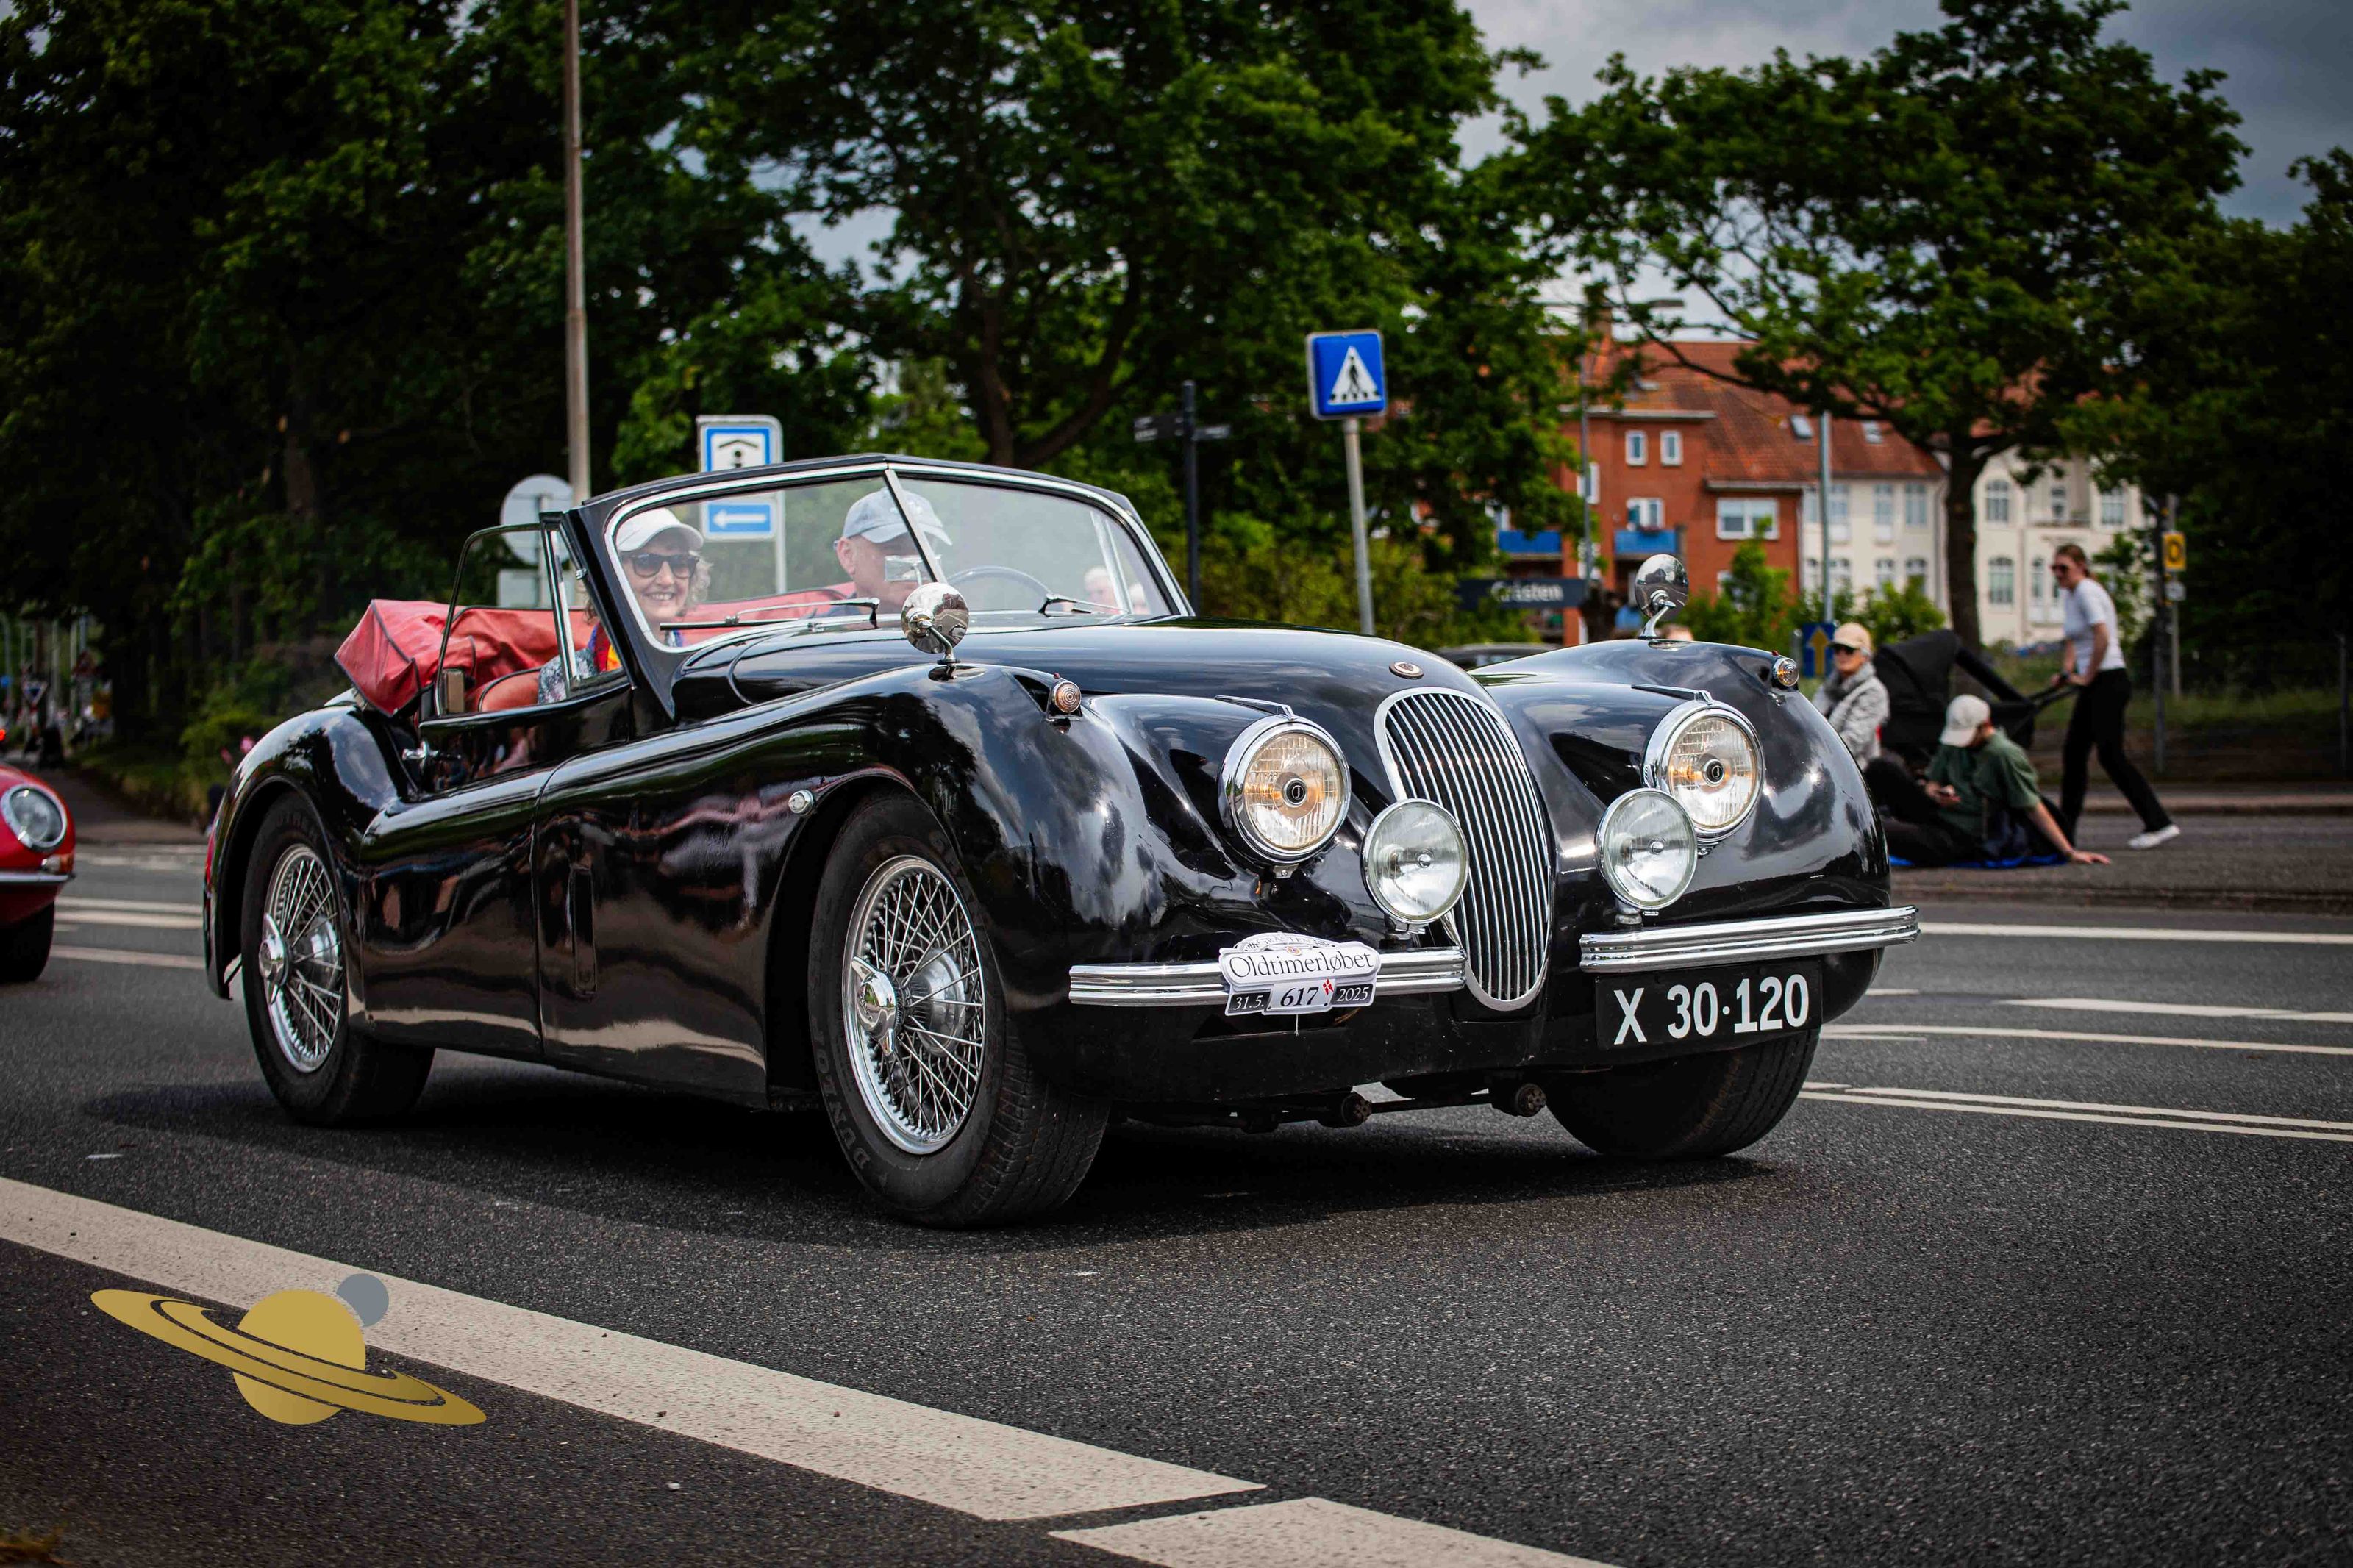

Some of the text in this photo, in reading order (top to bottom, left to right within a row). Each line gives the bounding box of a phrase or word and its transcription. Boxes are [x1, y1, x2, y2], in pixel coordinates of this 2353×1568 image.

[1229, 951, 1374, 977] Oldtimerløbet
[1232, 986, 1370, 1011] 31.5. 617 2025
[1613, 987, 1648, 1045] X
